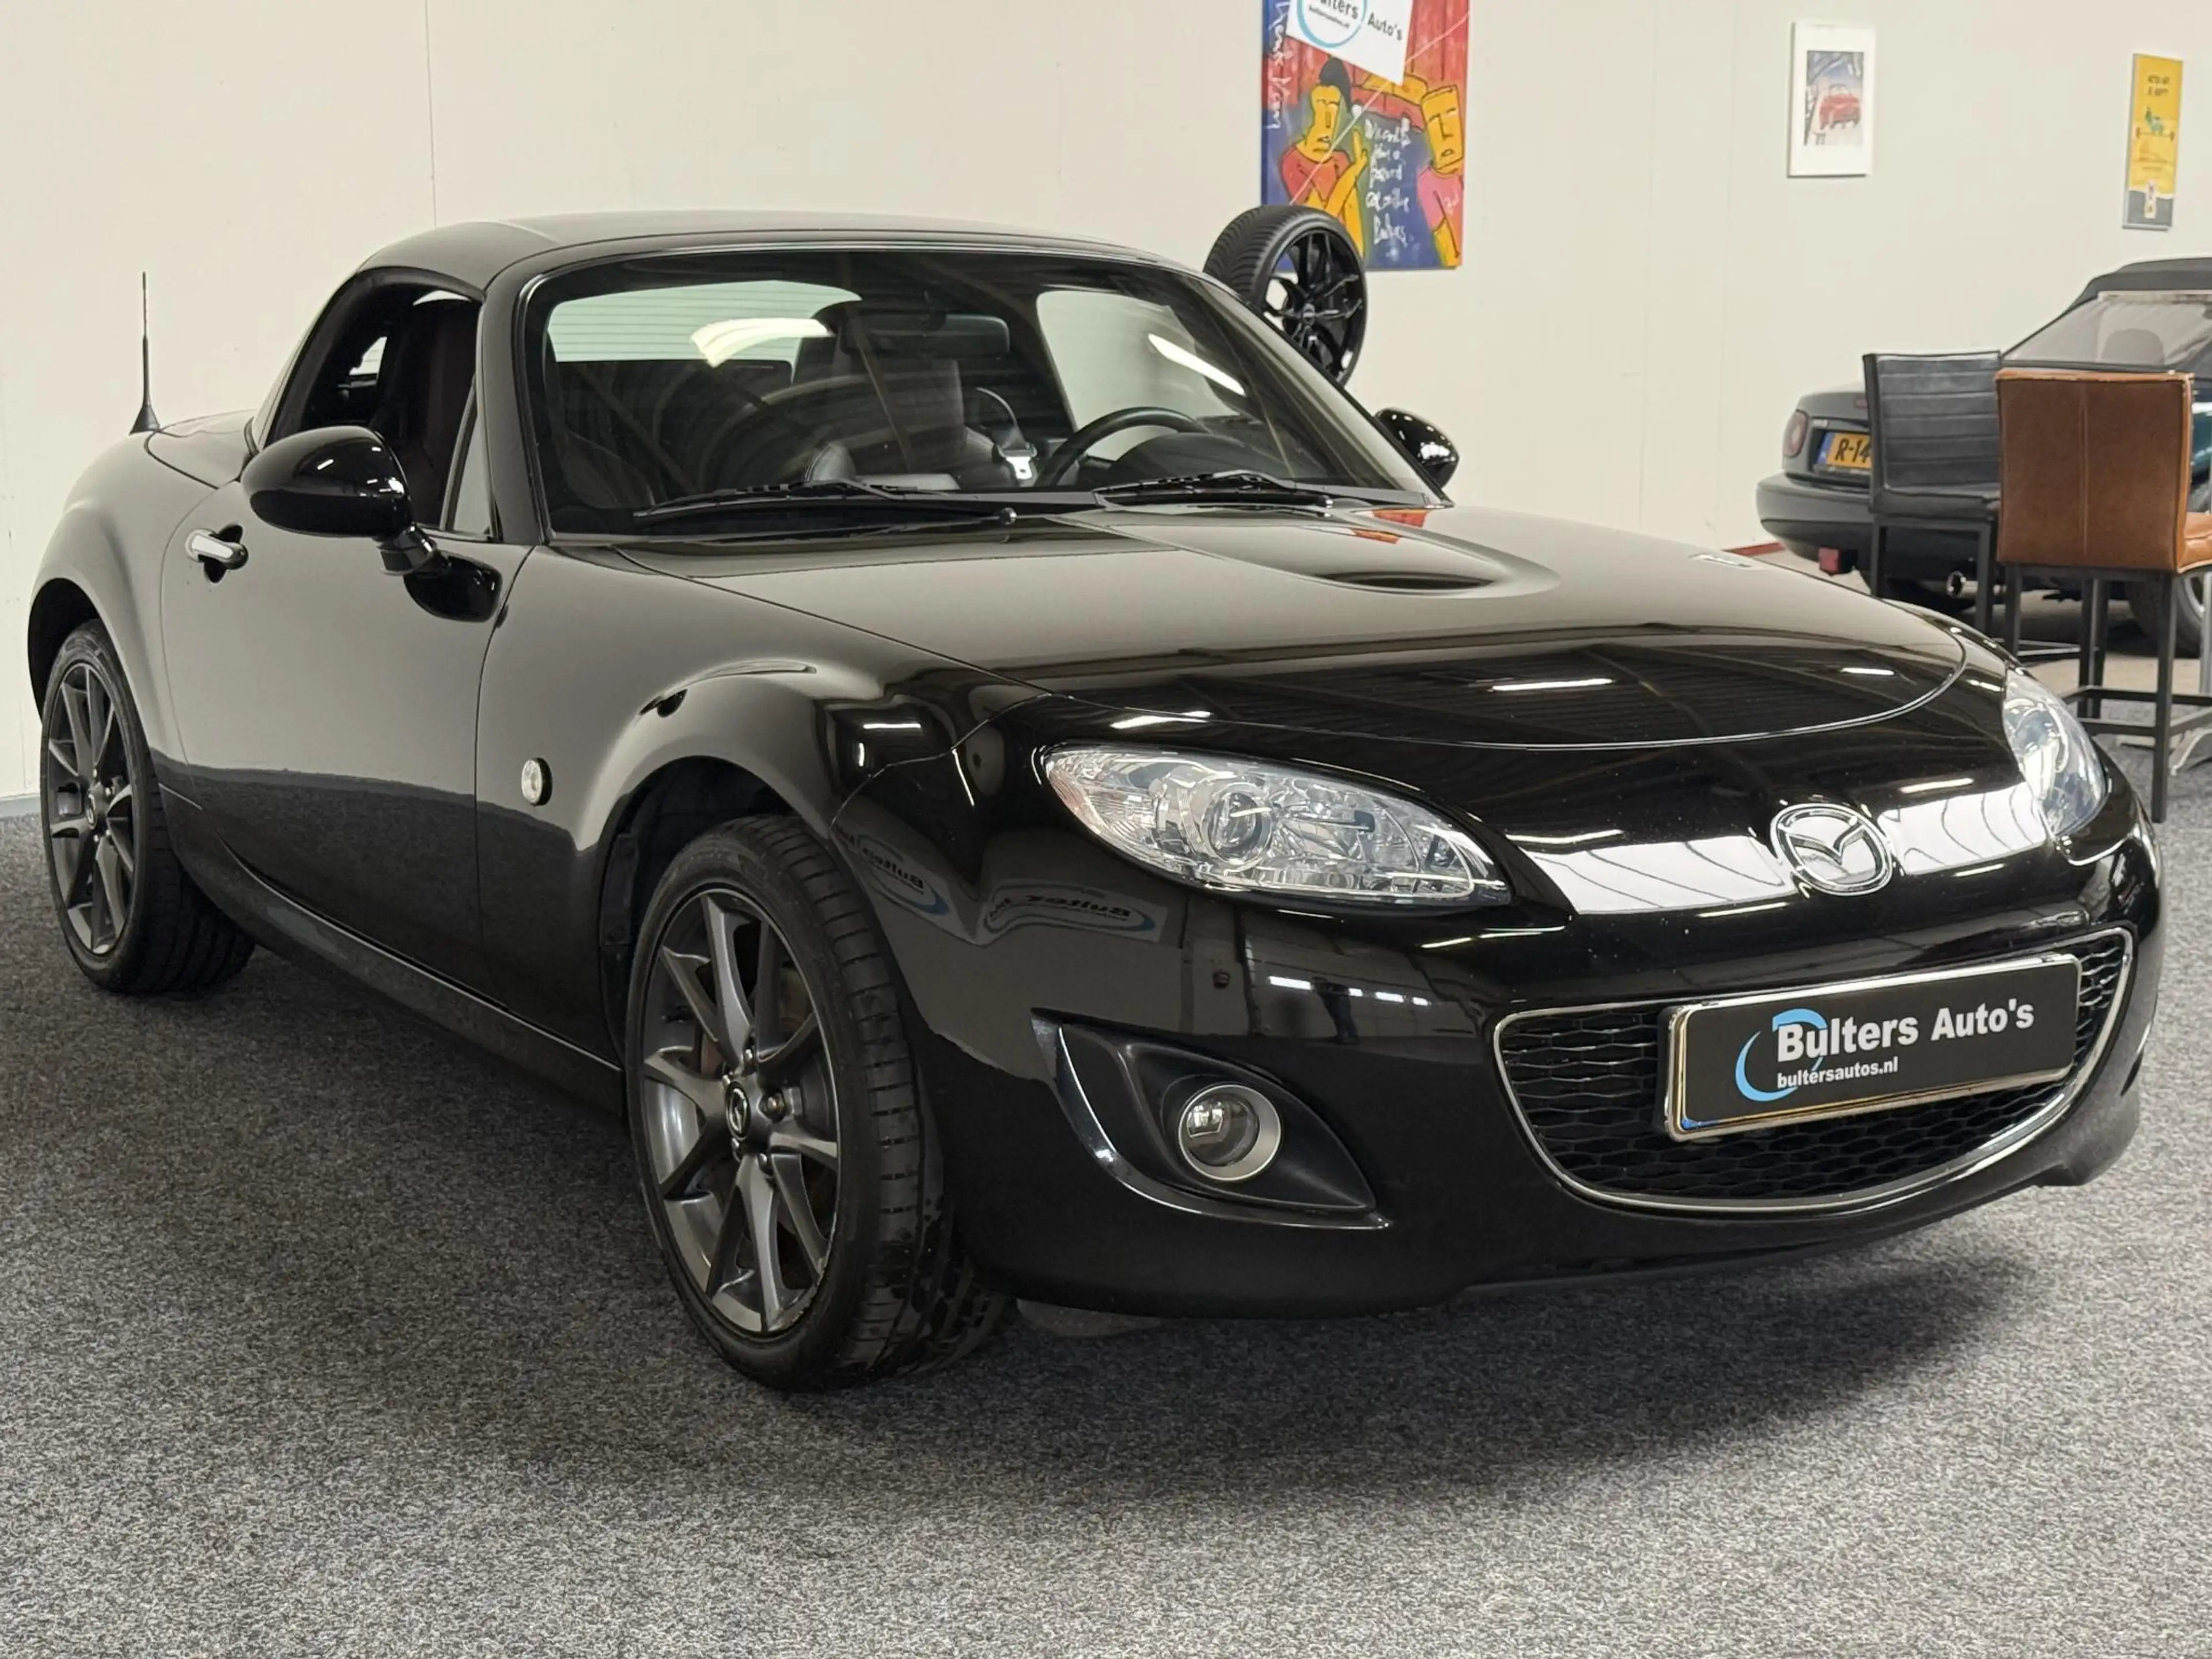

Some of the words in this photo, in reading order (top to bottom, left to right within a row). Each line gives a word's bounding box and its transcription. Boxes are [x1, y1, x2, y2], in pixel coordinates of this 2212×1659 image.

[1367, 12, 1403, 41] Auto's
[1777, 1016, 1919, 1062] Bulters
[1930, 998, 2035, 1041] Auto's
[1777, 1055, 1899, 1089] bultersautos.nl
